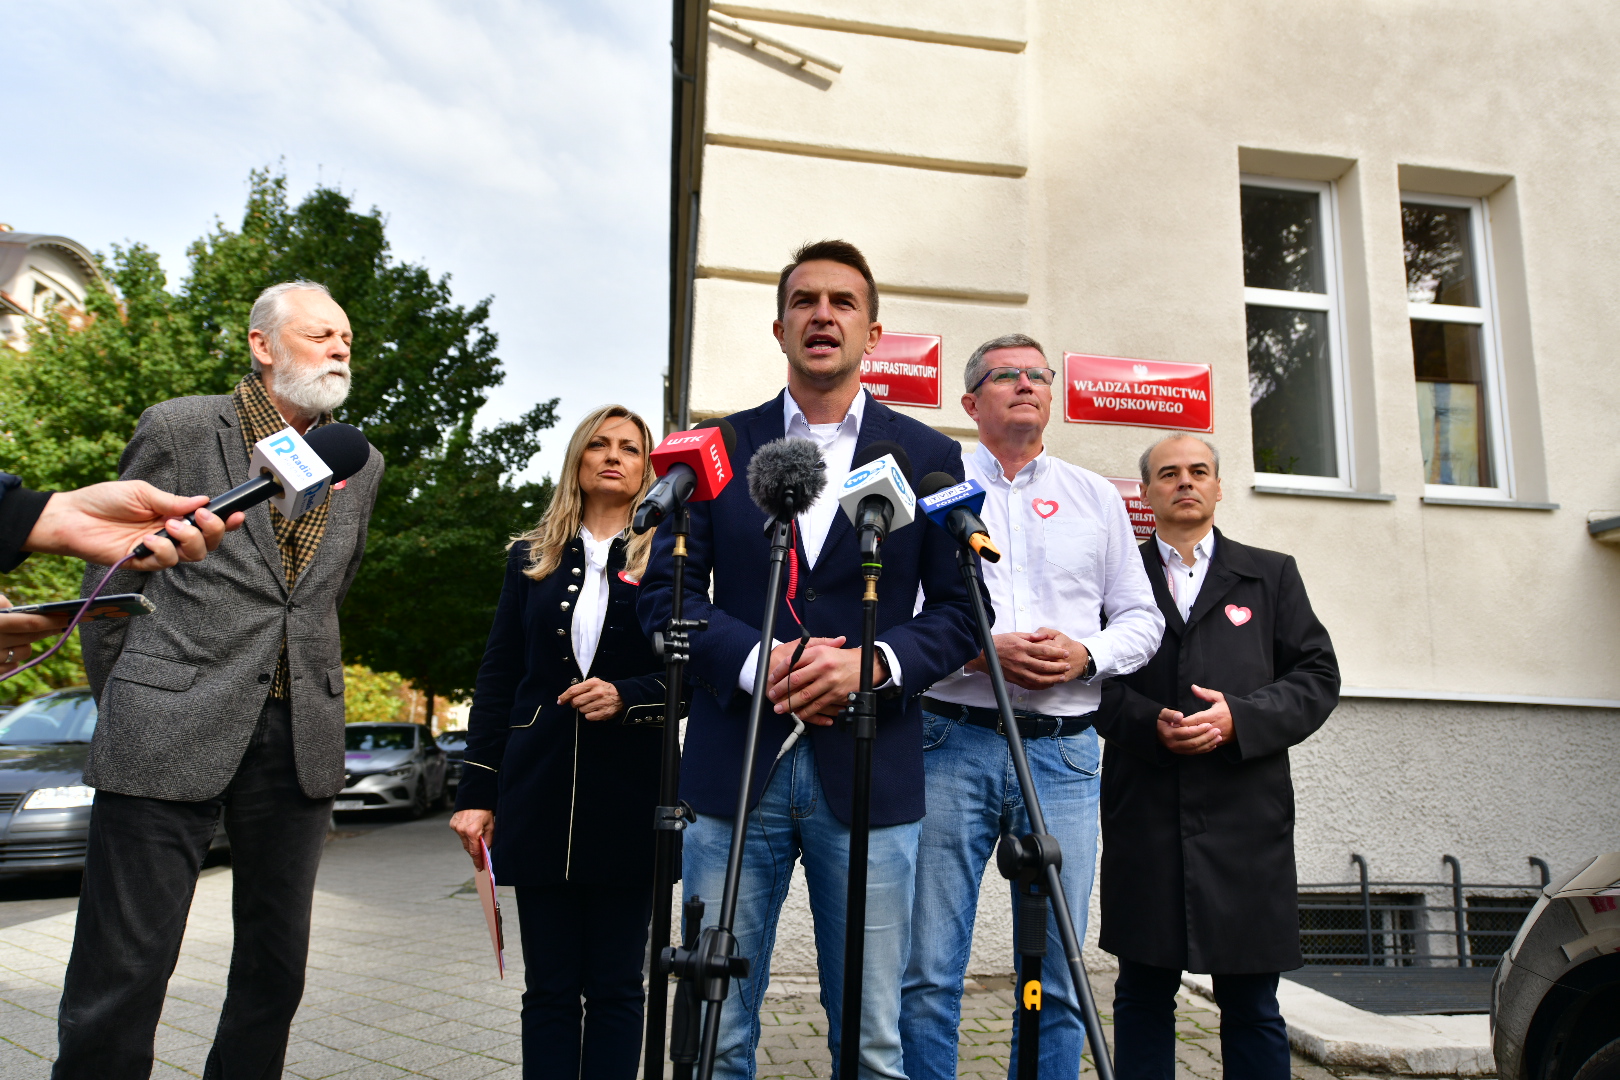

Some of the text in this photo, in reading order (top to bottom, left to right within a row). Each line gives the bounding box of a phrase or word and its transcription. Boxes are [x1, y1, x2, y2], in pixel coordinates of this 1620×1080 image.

[872, 361, 937, 378] INFRASTRUKTURY
[1074, 380, 1207, 401] WŁADZA LOTNICTWA
[1093, 396, 1183, 414] WOJSKOWEGO
[290, 454, 313, 478] Radio
